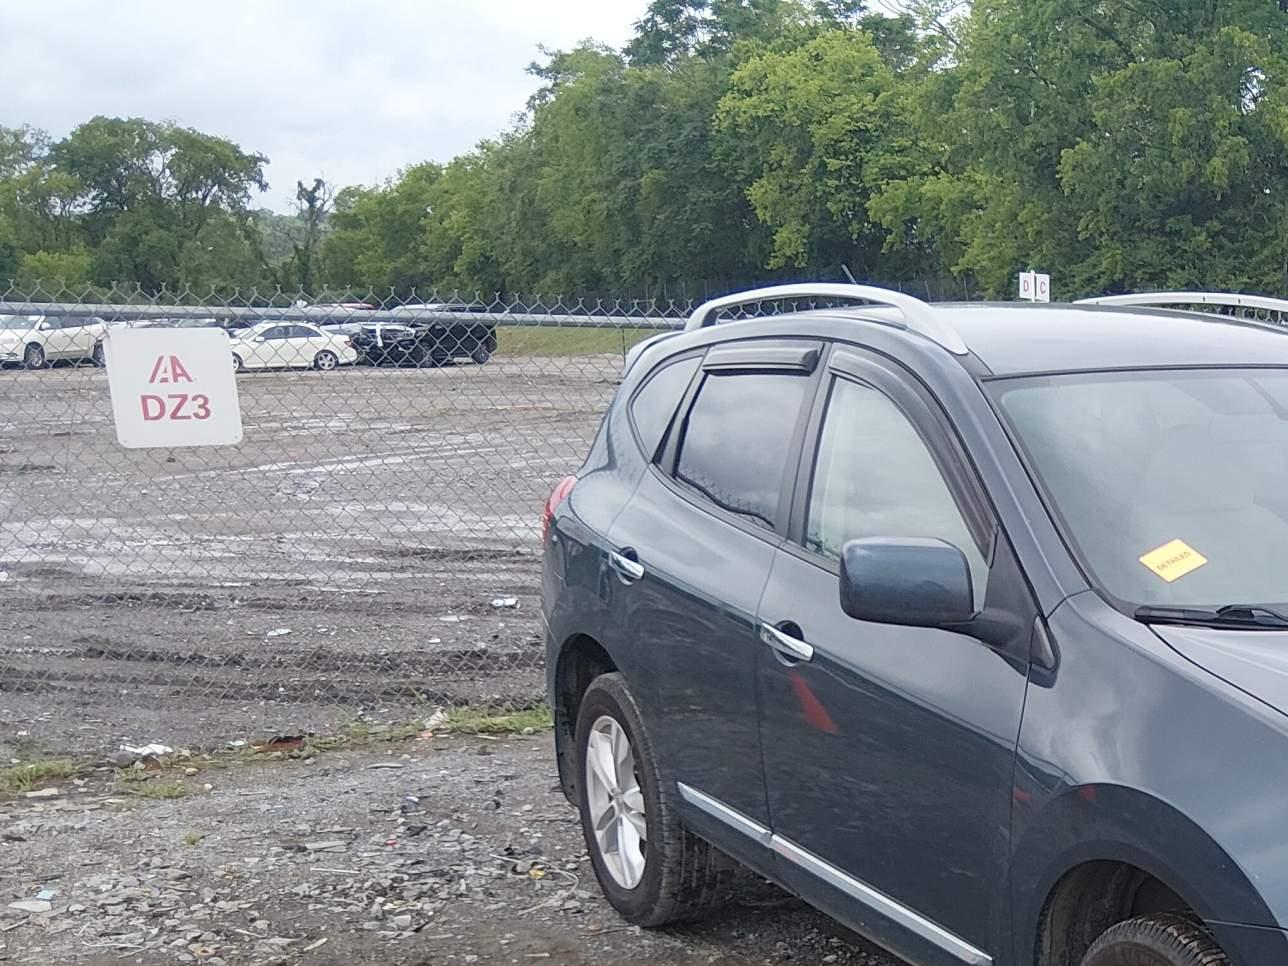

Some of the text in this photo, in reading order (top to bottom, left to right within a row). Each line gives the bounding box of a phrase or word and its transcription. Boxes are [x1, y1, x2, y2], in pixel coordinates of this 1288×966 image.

[1023, 280, 1030, 292] D
[1039, 281, 1046, 294] C
[140, 393, 212, 421] DZ3
